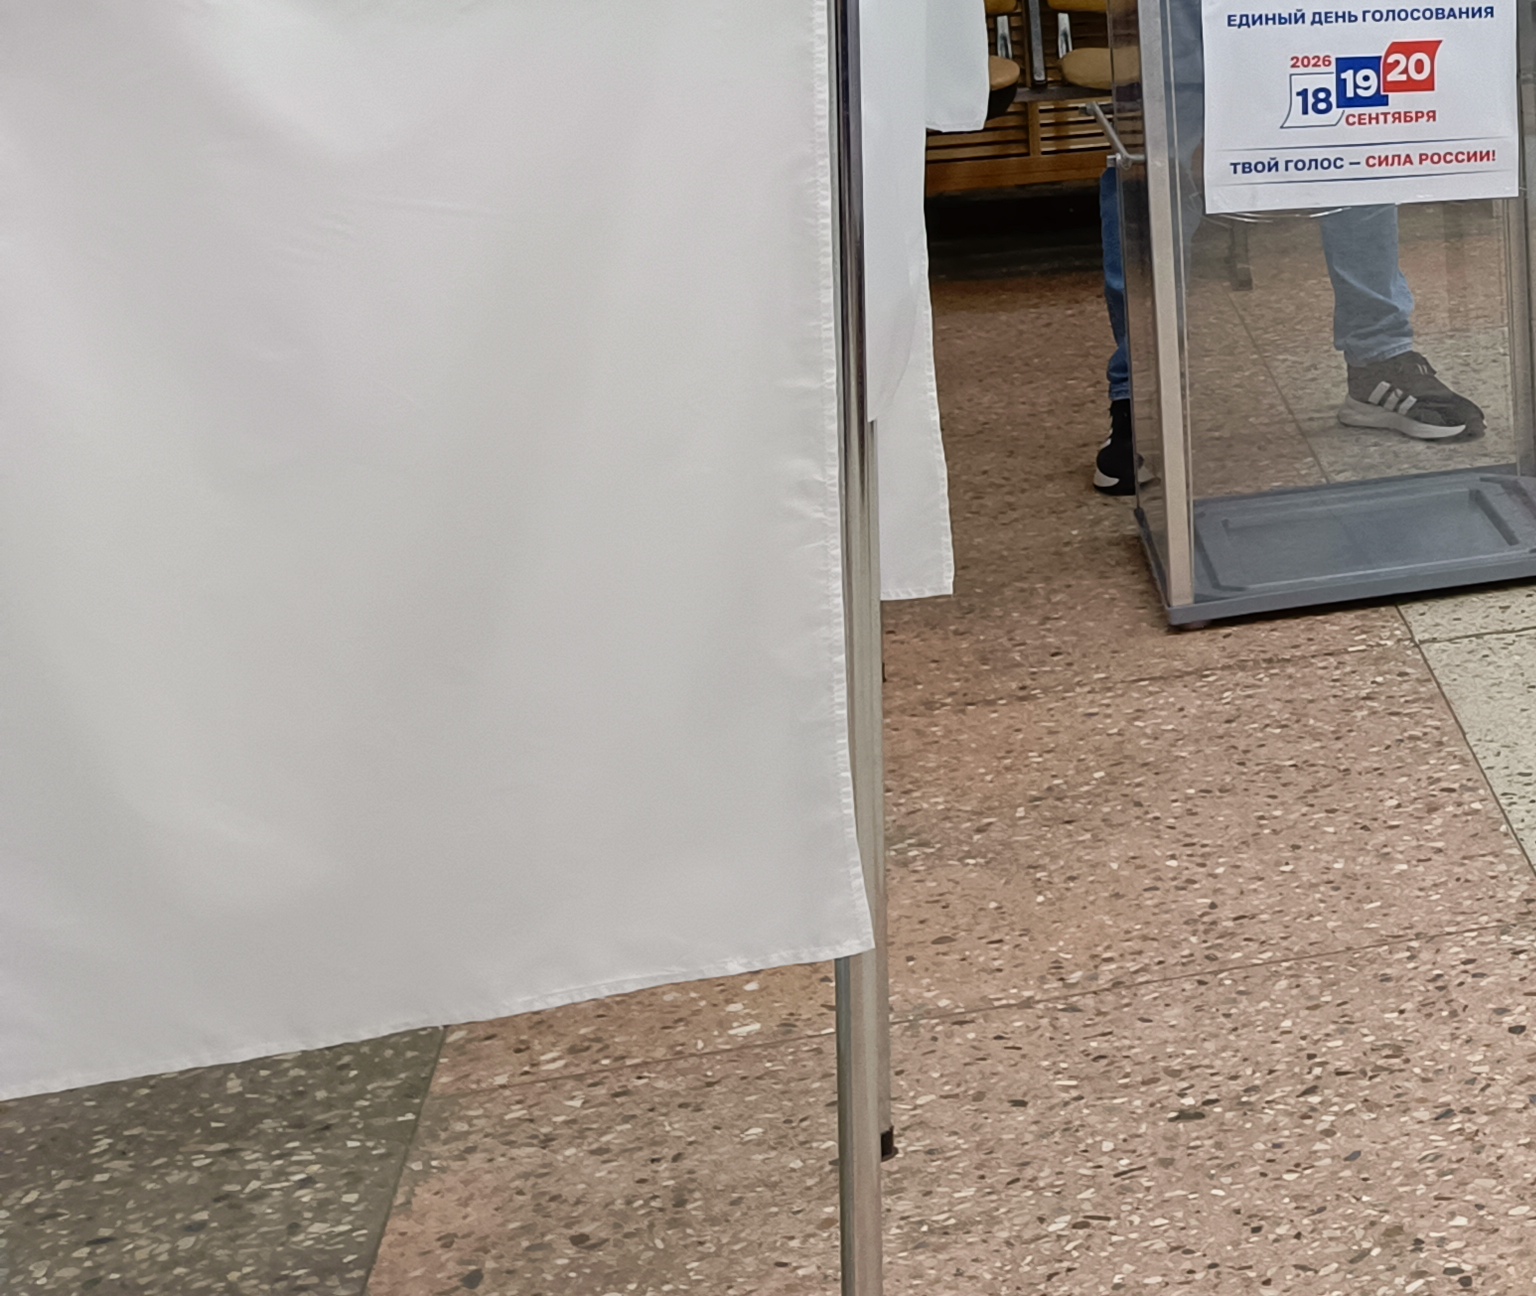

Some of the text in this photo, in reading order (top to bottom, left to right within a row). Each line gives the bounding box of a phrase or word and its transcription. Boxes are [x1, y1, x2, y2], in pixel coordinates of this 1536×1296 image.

[1226, 6, 1495, 28] ЕДИНЫЙ ДЕНЬ ГОЛОСОВАНИЯ
[1290, 55, 1332, 68] 2026
[1296, 52, 1431, 115] 18 19 20
[1344, 110, 1437, 127] СЕНТЯБРЯ
[1230, 157, 1279, 175] ТВОЙ
[1284, 157, 1344, 172] ГОЛОС
[1365, 154, 1414, 168] СИЛА
[1418, 149, 1496, 166] РОССИИ!
